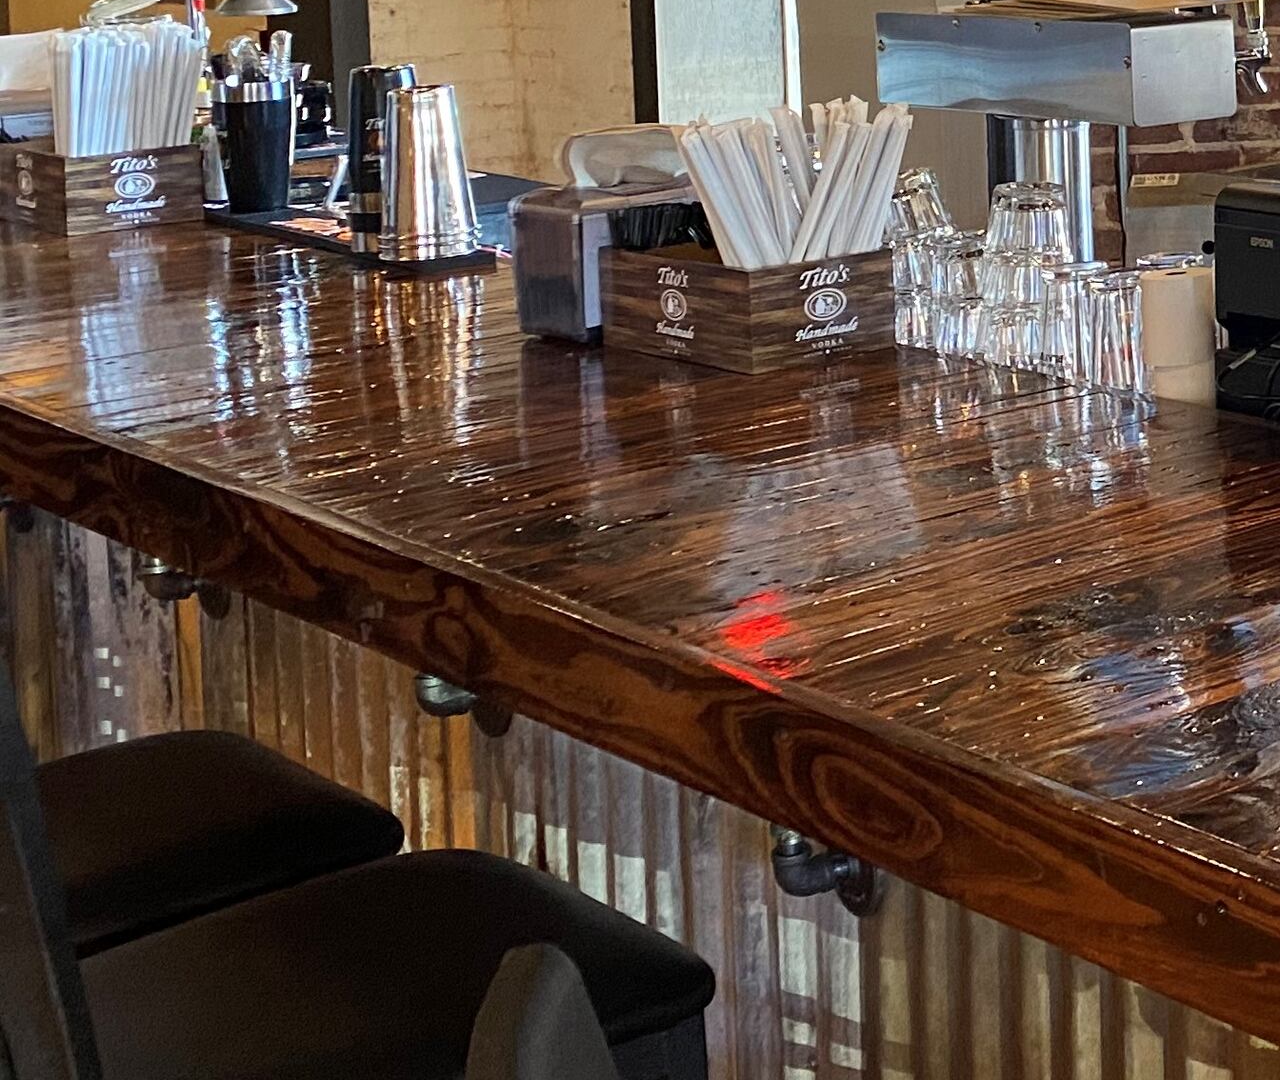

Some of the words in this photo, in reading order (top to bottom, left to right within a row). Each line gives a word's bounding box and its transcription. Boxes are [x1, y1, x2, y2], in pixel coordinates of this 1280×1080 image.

[1249, 236, 1274, 249] EPSON
[794, 316, 859, 342] Handmade
[811, 336, 845, 350] VODKA
